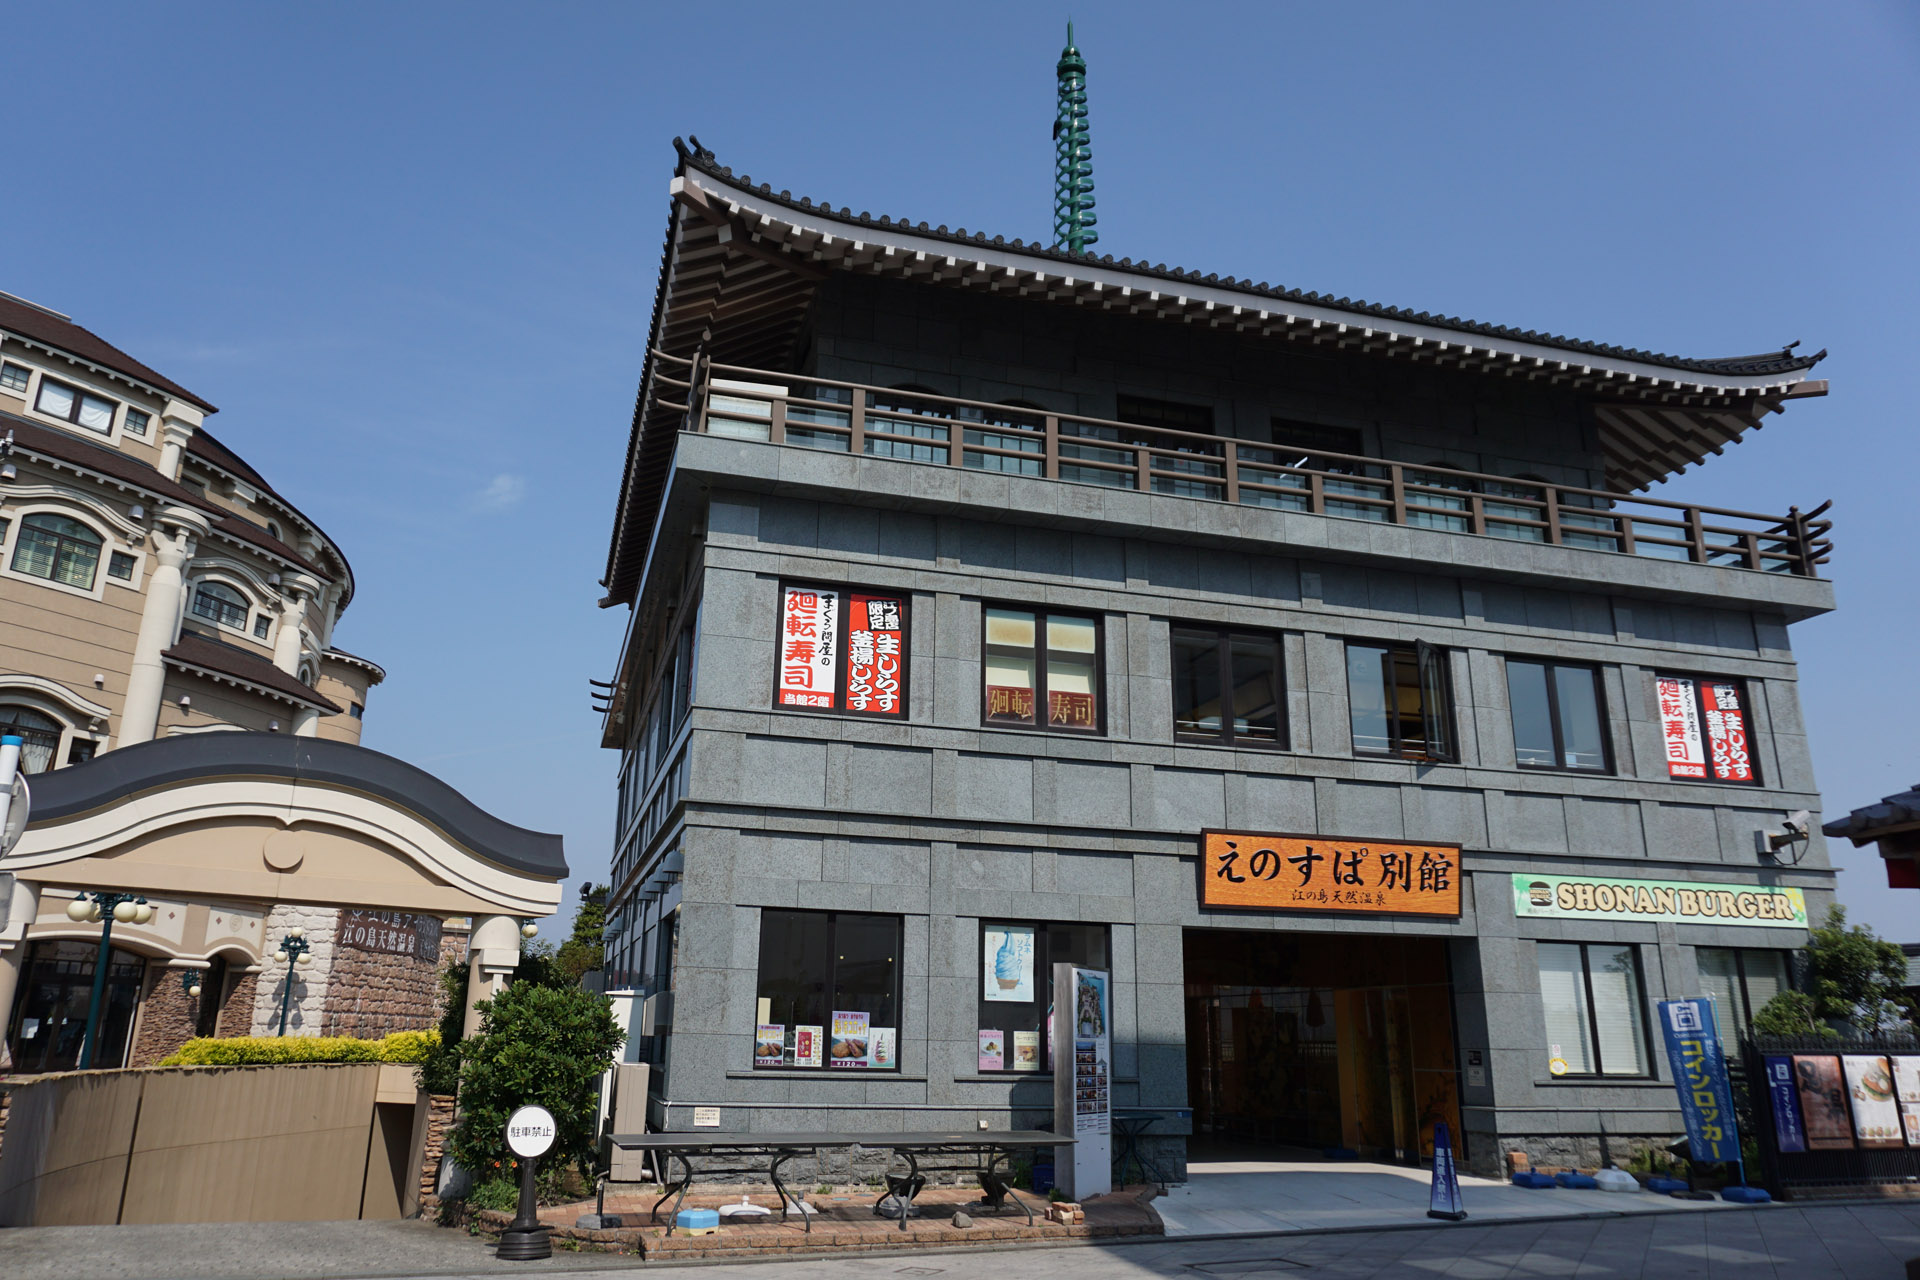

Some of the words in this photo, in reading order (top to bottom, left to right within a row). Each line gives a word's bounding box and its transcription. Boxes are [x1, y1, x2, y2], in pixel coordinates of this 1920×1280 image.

[784, 590, 818, 689] 廻転寿司
[818, 593, 835, 666] まぐろ問屋の
[784, 693, 830, 708] 当館2階
[848, 629, 875, 711] 釜揚しらす
[875, 633, 900, 712] 生しらす
[1658, 678, 1690, 761] 廻転寿司
[1724, 712, 1751, 779] 生しらす
[1217, 840, 1455, 894] えのすぱ別館
[1291, 888, 1387, 906] 江の島天然温泉
[1556, 882, 1676, 915] SHONAN
[1678, 888, 1796, 921] BURGER
[342, 922, 416, 954] 江の島天然温泉
[510, 1126, 552, 1137] 駐車禁止
[1680, 1040, 1723, 1159] コインロッカー
